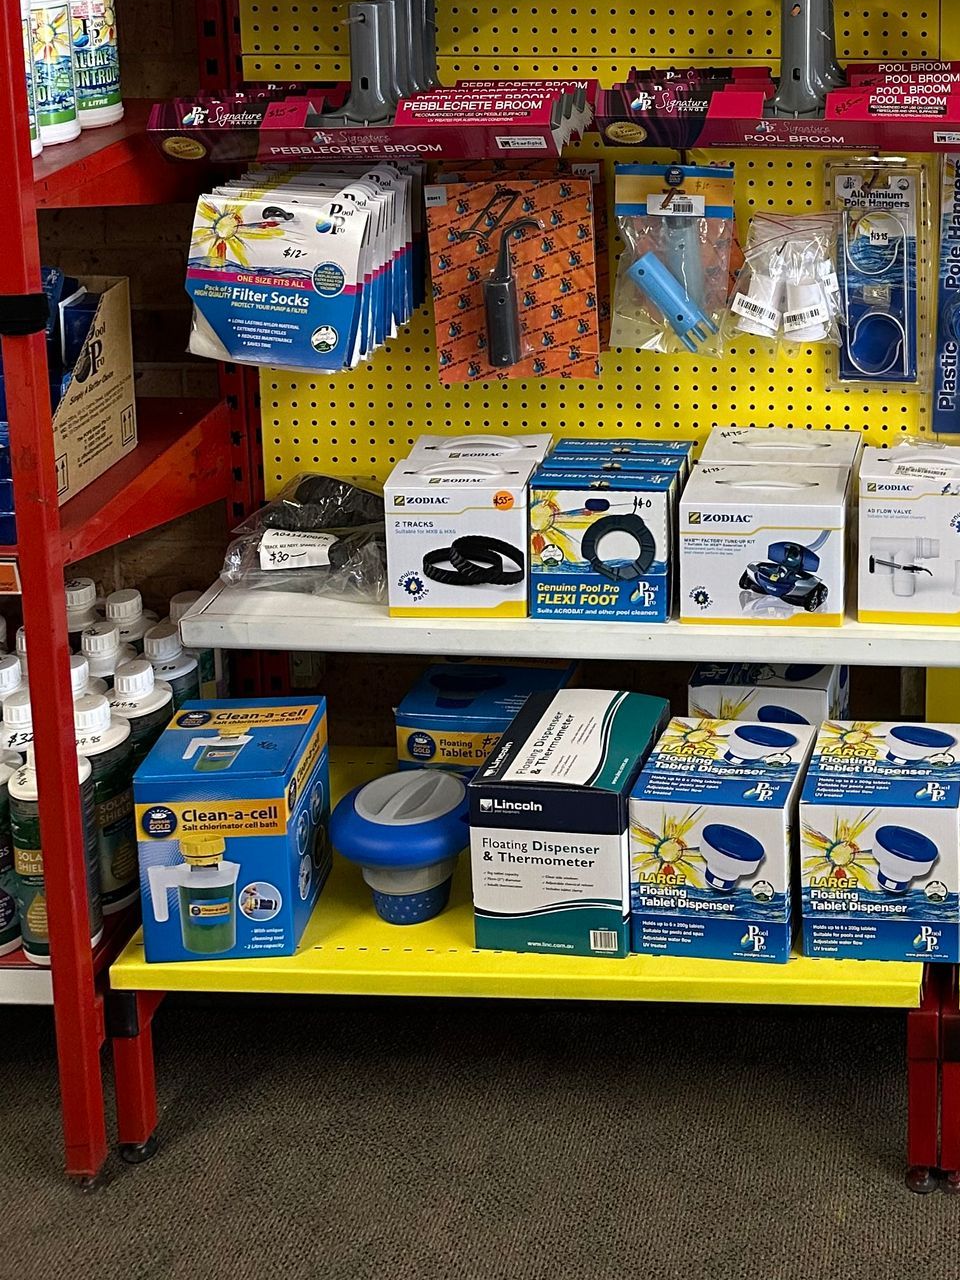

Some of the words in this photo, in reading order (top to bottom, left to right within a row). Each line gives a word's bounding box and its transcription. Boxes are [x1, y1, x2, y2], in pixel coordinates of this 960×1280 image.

[885, 75, 914, 83] POOL
[917, 74, 960, 83] BROOM
[403, 100, 492, 111] PEBBLECRETE
[495, 99, 543, 110] BROOM
[869, 95, 901, 105] POOL
[904, 96, 947, 106] BROOM
[744, 134, 786, 143] POOL
[789, 134, 845, 144] BROOM
[270, 144, 380, 155] PEBBLECRETE
[383, 142, 443, 153] BROOM
[851, 190, 903, 199] Aluminium
[844, 198, 866, 208] Pole
[869, 199, 909, 209] Hangers
[237, 274, 253, 283] ONE
[255, 276, 272, 285] SIZE
[273, 279, 289, 287] FITS
[232, 287, 268, 303] Filter
[270, 291, 310, 307] Socks
[938, 342, 958, 411] Plastic
[703, 514, 751, 523] ZODIAC
[537, 583, 576, 592] Genuine
[580, 584, 600, 593] Pool
[603, 584, 620, 593] Pro
[537, 593, 576, 605] FLEXI
[580, 594, 619, 606] FOOT
[215, 709, 307, 721] Clean-a-cell
[440, 739, 472, 748] Floating
[660, 746, 716, 757] LARGE
[821, 747, 877, 757] LARGE
[658, 754, 713, 765] Floating
[819, 756, 876, 766] Floating
[654, 761, 691, 773] Tablet
[693, 765, 766, 776] Dispenser
[818, 763, 856, 774] Tablet
[858, 765, 933, 777] Dispenser
[494, 800, 543, 811] Lincoln
[182, 807, 278, 823] Clean-a-cell
[199, 822, 242, 831] chlorinator
[244, 821, 259, 829] cell
[260, 820, 278, 829] bath
[482, 838, 528, 852] Floating
[532, 841, 600, 856] Dispenser
[483, 852, 493, 862] &
[500, 852, 595, 868] Thermometer
[639, 873, 685, 885] LARGE
[811, 877, 857, 889] LARGE
[640, 886, 686, 898] Floating
[811, 890, 858, 902] Floating
[640, 897, 676, 908] Tablet
[678, 899, 735, 912] Dispenser
[811, 900, 848, 912] Tablet
[850, 902, 907, 914] Dispenser
